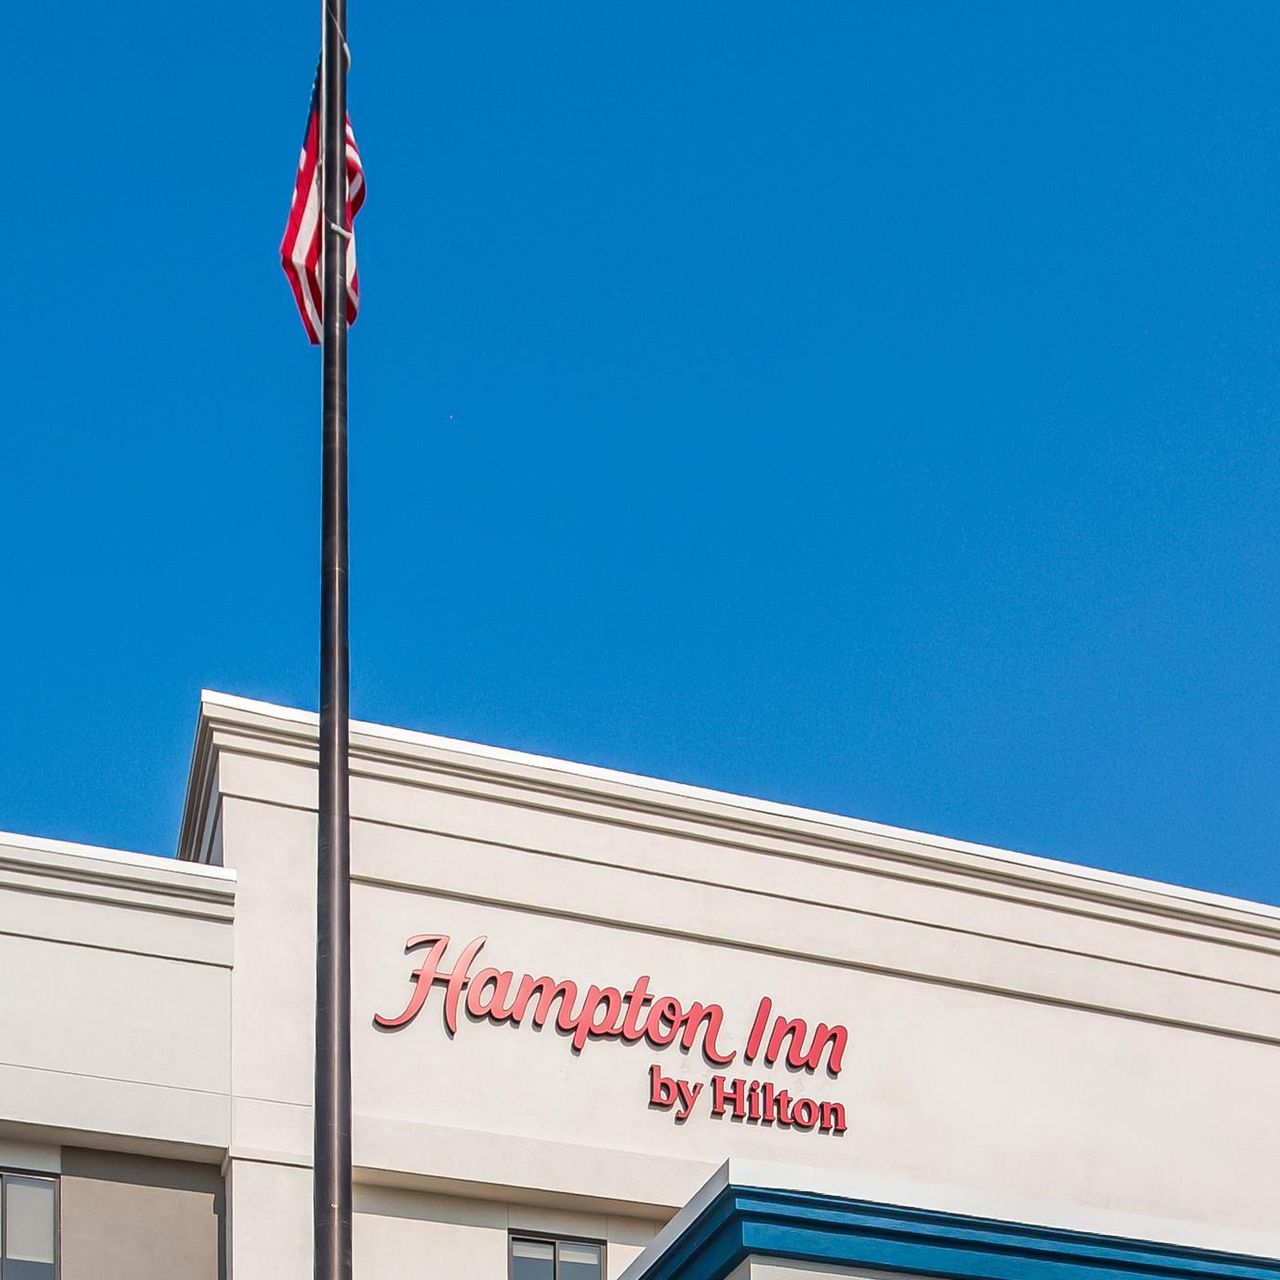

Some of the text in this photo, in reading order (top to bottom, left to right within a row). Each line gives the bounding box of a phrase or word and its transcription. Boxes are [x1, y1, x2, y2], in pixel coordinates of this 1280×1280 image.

[373, 933, 849, 1076] Hampton Inn
[648, 1064, 848, 1135] by Hilton
